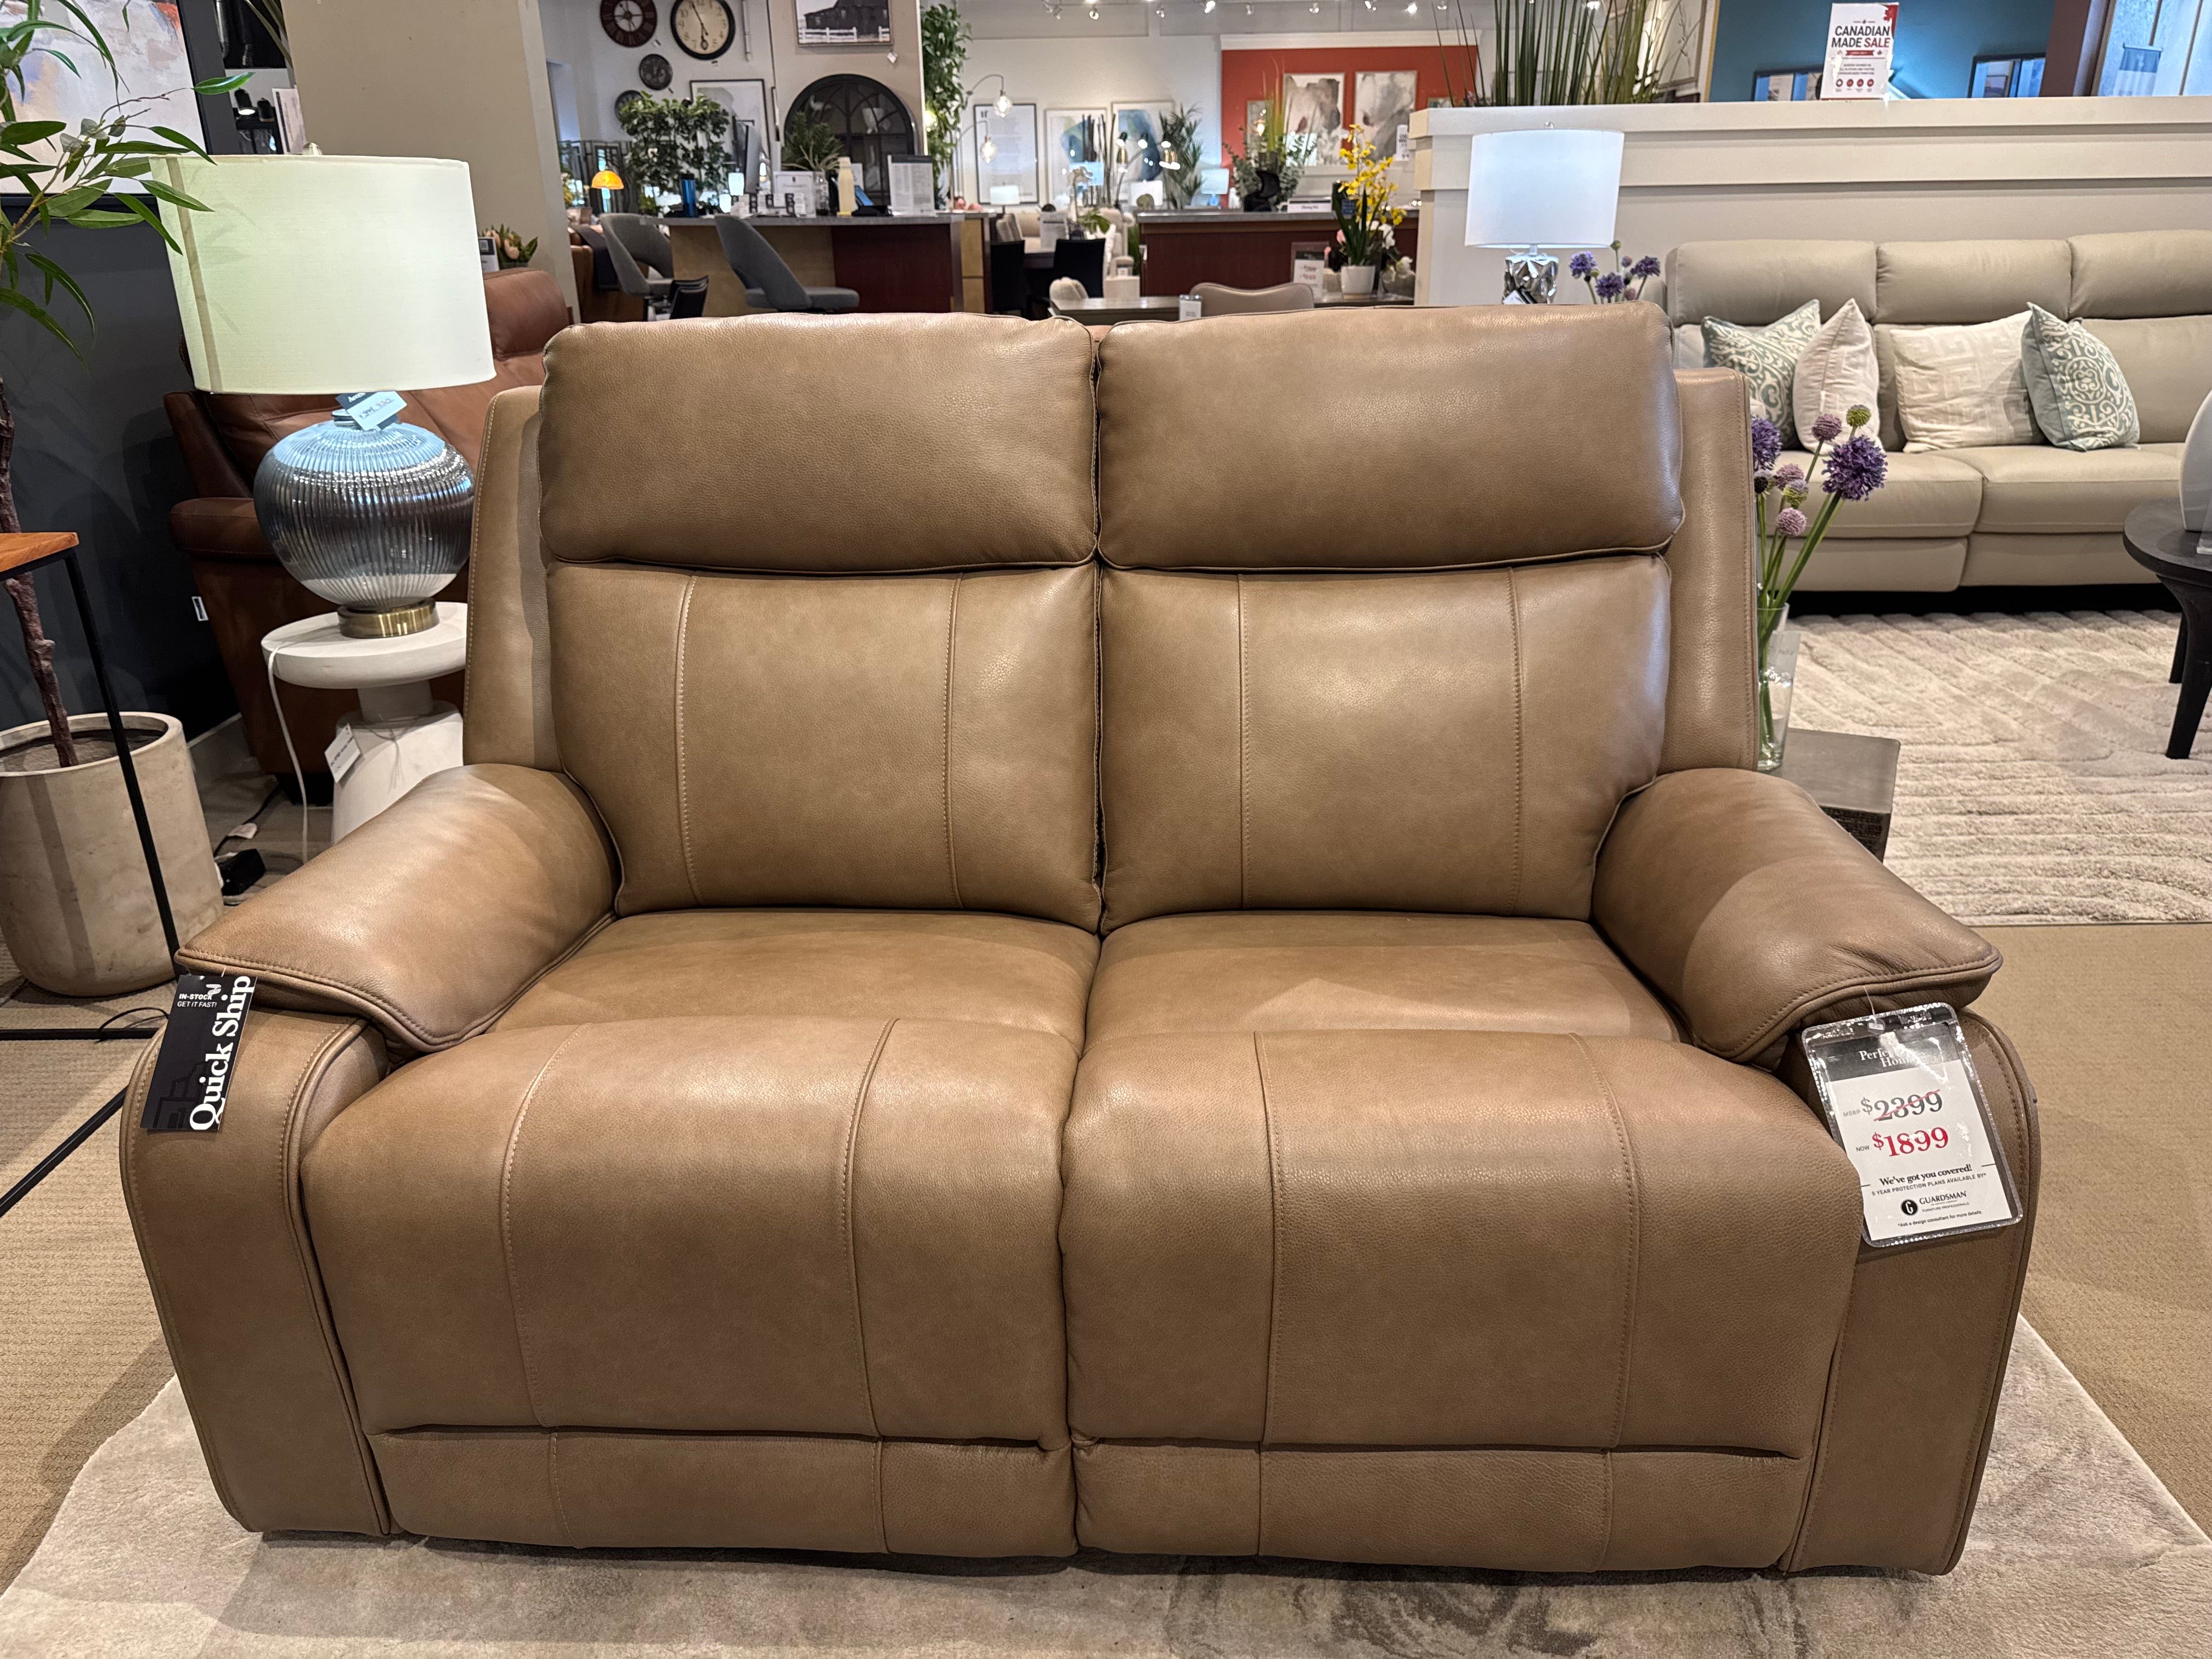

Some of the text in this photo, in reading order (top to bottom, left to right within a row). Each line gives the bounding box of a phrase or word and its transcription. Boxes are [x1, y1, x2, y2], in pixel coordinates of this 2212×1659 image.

[1835, 26, 1890, 36] CANADIAN
[1831, 37, 1891, 48] MADE SALE
[189, 976, 255, 1130] Quick Ship
[1861, 1091, 1943, 1121] $2399
[1872, 1127, 1949, 1156] $1899
[1879, 1164, 1972, 1186] We've got you covered!
[1892, 1183, 1926, 1192] PROTECTION
[1927, 1179, 1945, 1187] PLANS
[1947, 1175, 1975, 1183] AVAILABLE
[1920, 1190, 1966, 1204] GUARDSMAN
